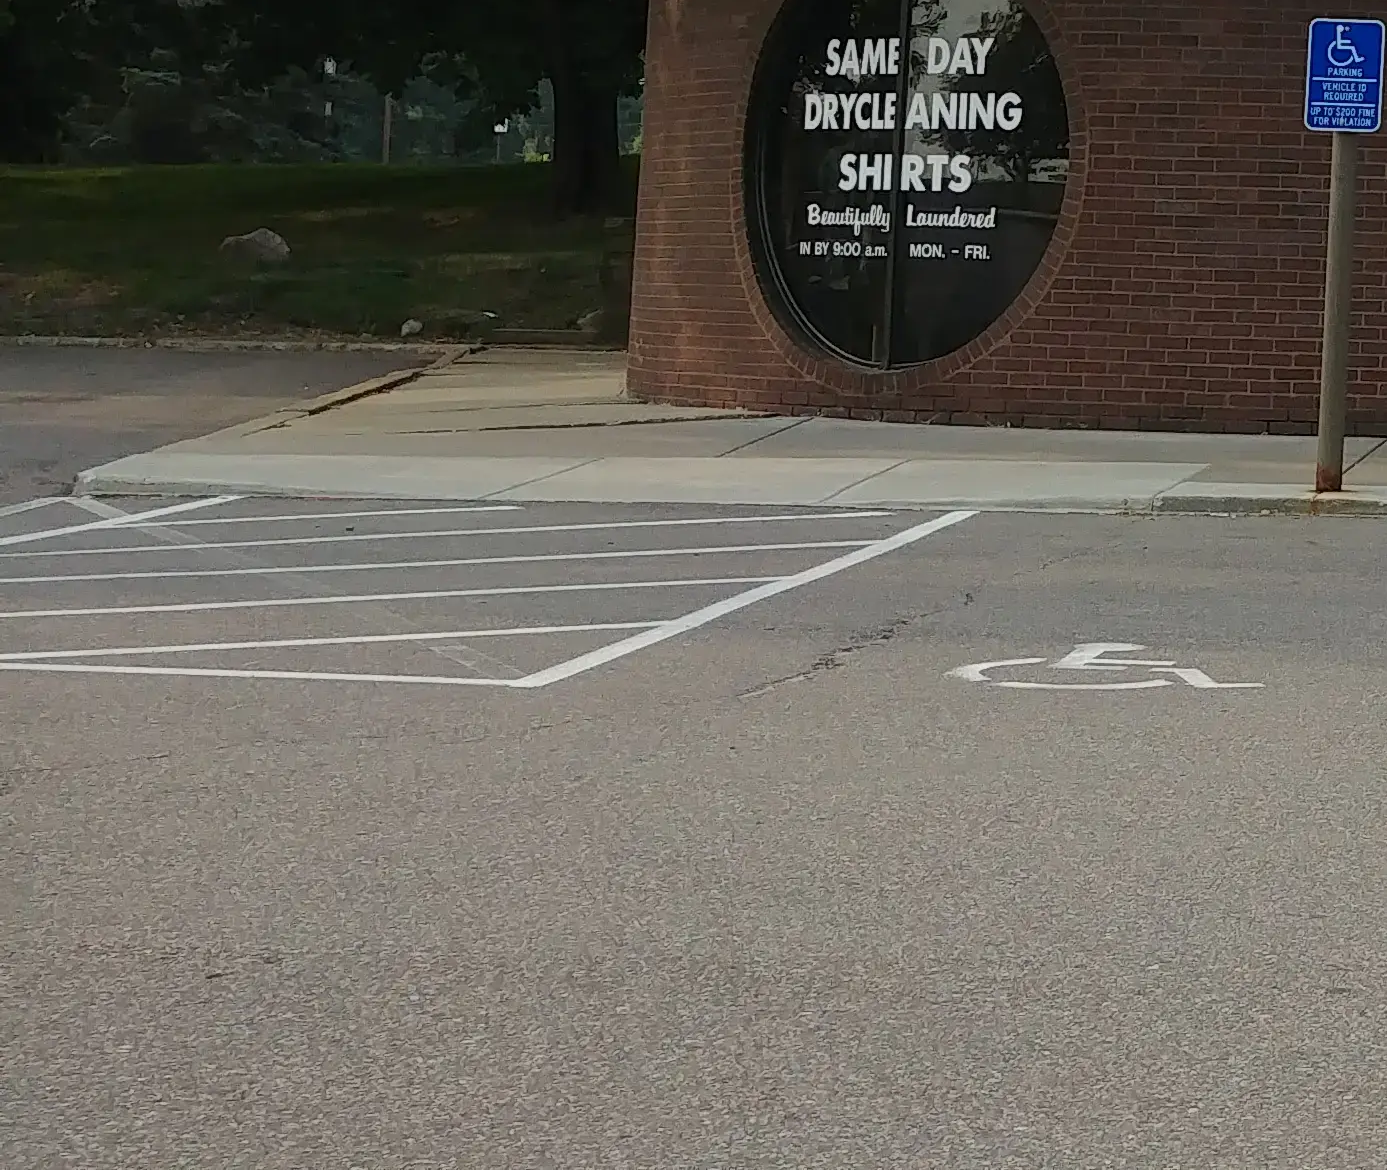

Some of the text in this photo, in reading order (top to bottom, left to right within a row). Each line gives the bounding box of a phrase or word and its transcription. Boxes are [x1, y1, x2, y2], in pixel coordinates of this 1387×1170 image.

[825, 37, 995, 76] SAME DAY
[1327, 67, 1362, 77] PARKING
[1322, 82, 1367, 92] VEHICLE ID
[1324, 92, 1364, 101] REQUIRED
[1310, 107, 1375, 117] UP TO $200 FINE
[1314, 117, 1371, 126] FOR VIOLATION
[838, 153, 972, 193] SHIRTS
[806, 203, 997, 236] Beautifully Laundered
[800, 242, 810, 256] IN
[814, 242, 829, 256] BY
[832, 242, 861, 257] 9:00
[864, 245, 888, 257] a.m.
[909, 244, 946, 258] MON.
[964, 245, 991, 260] FRI.
